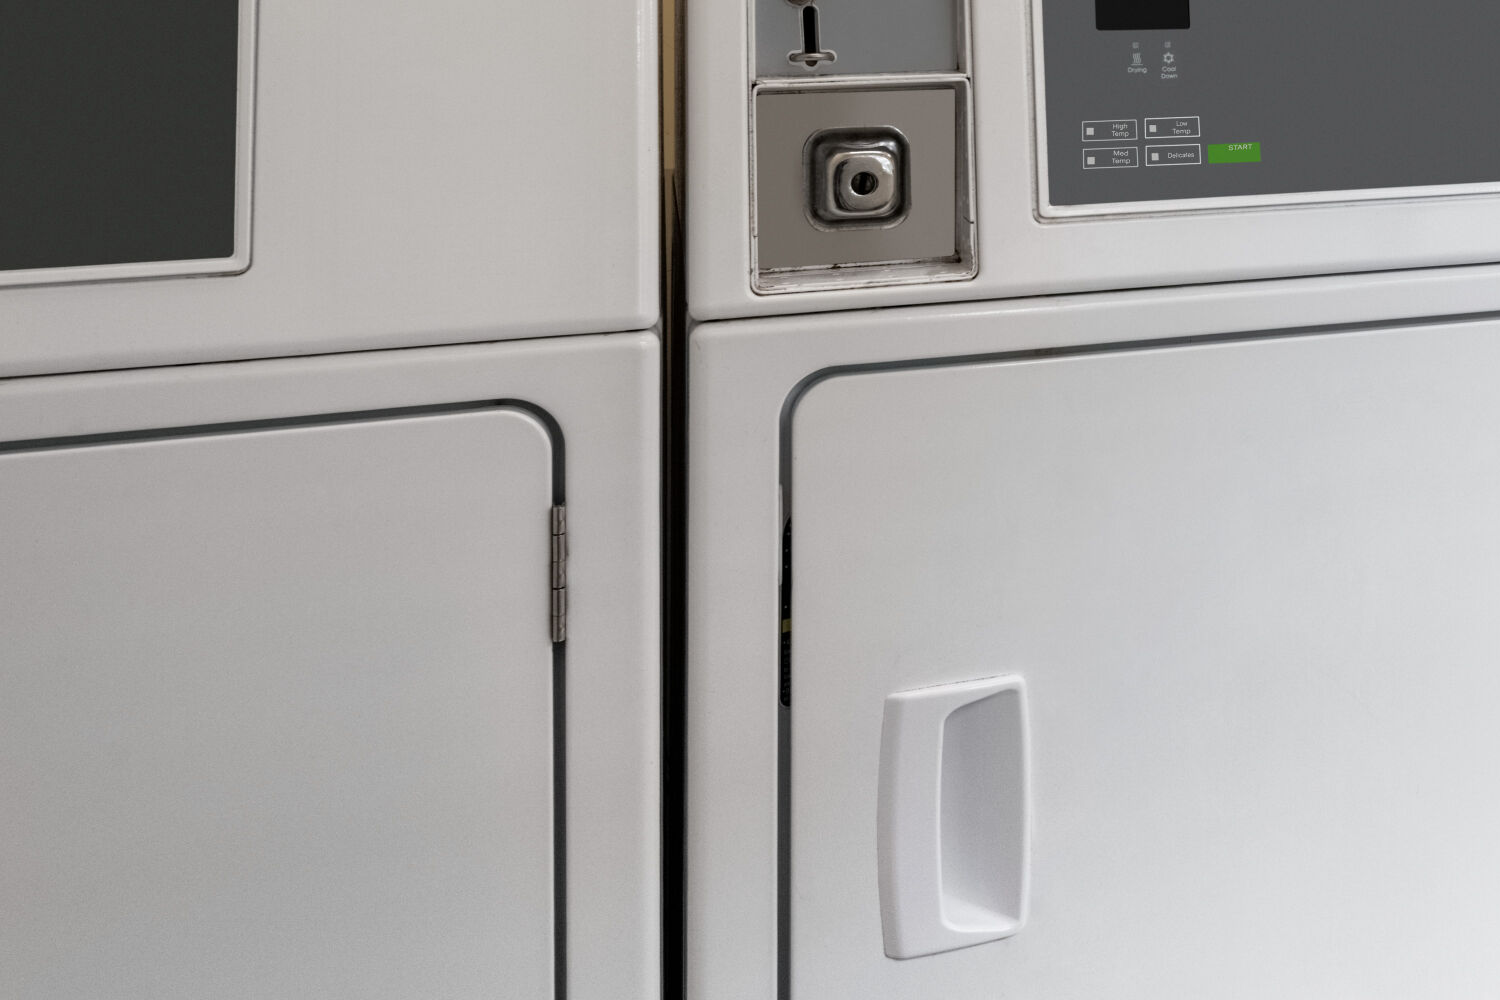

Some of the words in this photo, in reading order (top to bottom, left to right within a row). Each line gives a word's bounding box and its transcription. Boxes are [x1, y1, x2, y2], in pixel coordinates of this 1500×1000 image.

[1112, 123, 1128, 131] High
[1111, 130, 1130, 138] Temp
[1172, 128, 1191, 136] Temp
[1227, 143, 1253, 151] START
[1112, 157, 1131, 165] Temp
